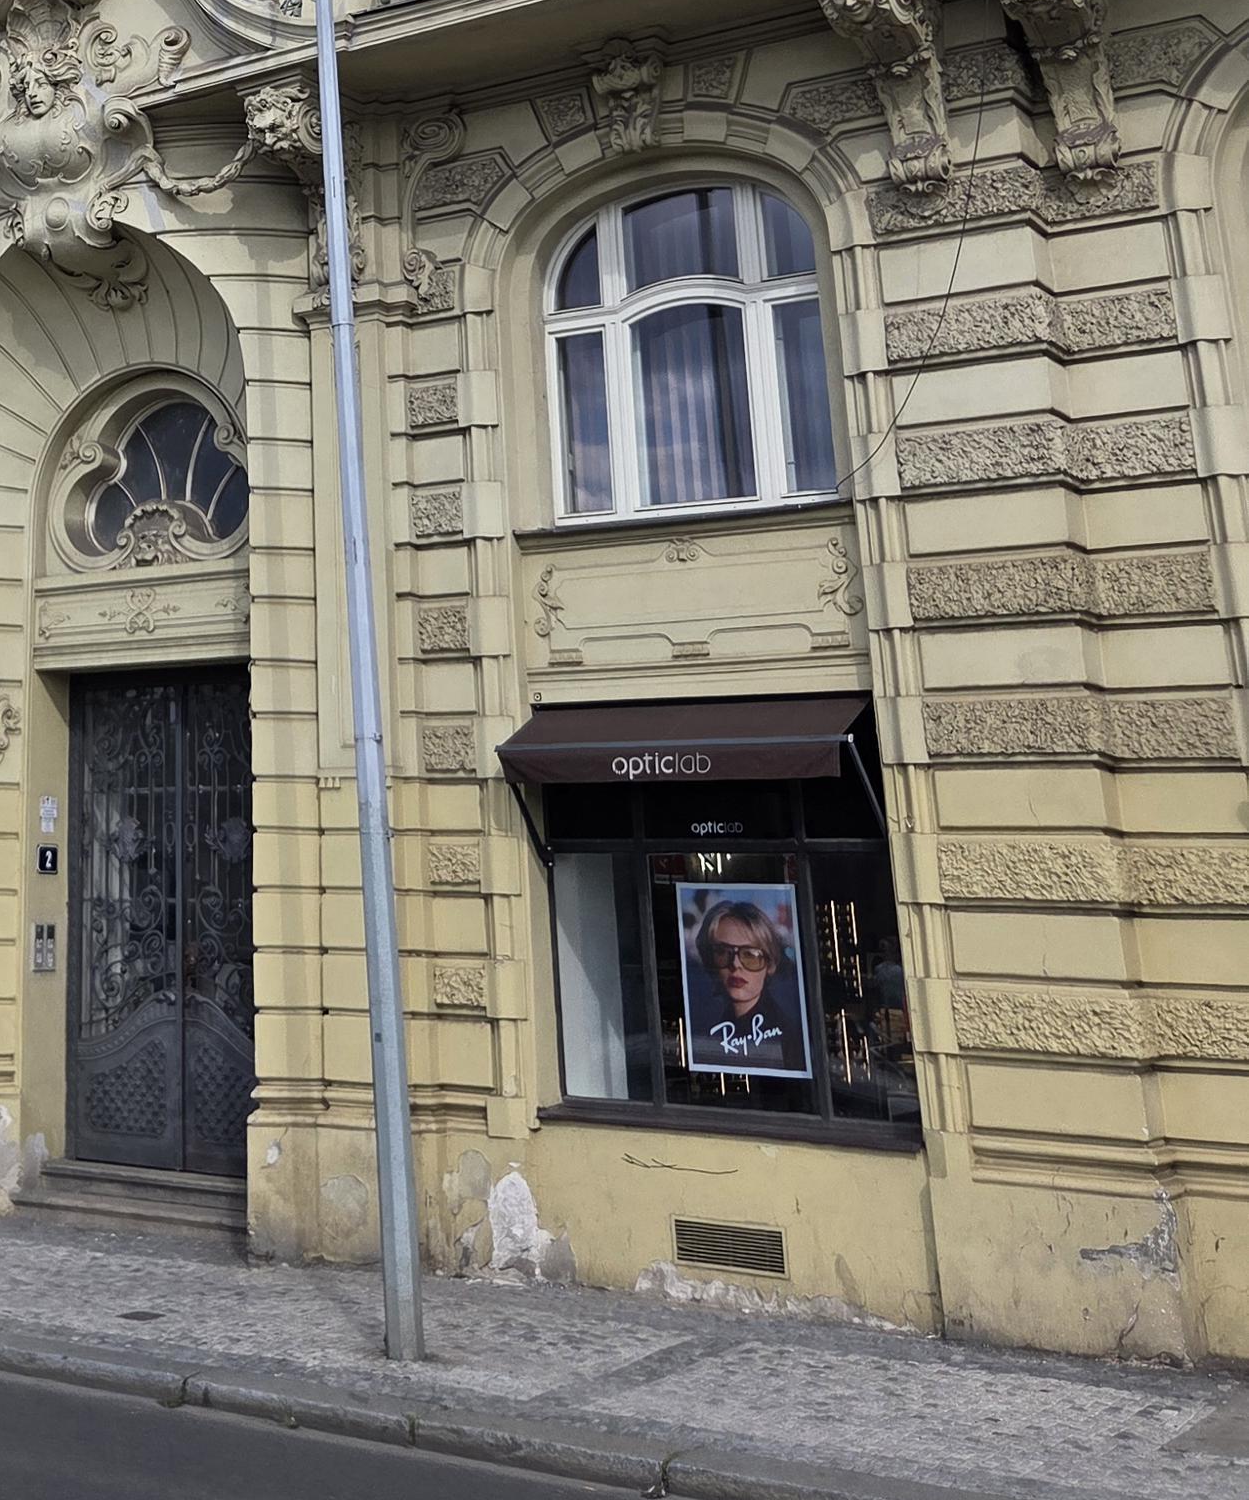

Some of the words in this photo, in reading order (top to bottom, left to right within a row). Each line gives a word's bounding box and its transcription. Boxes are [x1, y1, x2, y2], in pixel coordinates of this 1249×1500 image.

[612, 752, 711, 780] opticlab
[690, 820, 744, 836] opticlab
[45, 850, 52, 868] 2
